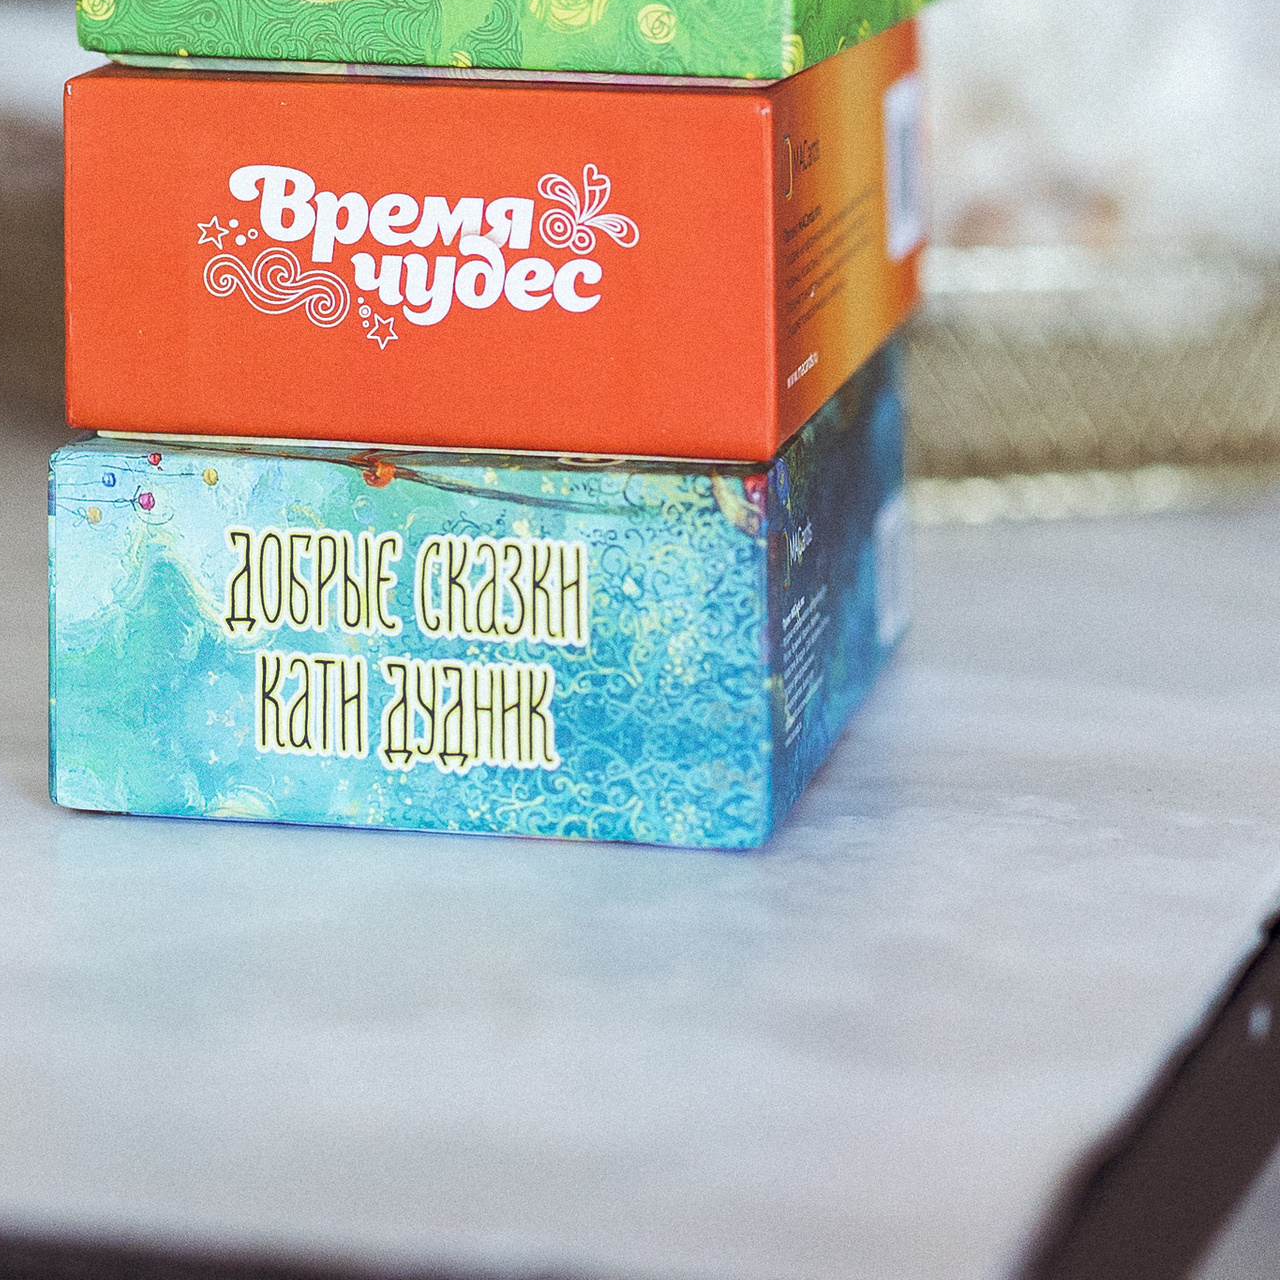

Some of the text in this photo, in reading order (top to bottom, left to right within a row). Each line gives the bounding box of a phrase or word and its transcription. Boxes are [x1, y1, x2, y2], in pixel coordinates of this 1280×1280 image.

[228, 163, 535, 263] Время
[350, 233, 604, 327] чудес
[224, 530, 584, 640] ДОБРЫЕ СКАЗКИ
[382, 662, 556, 768] ДУДНИК
